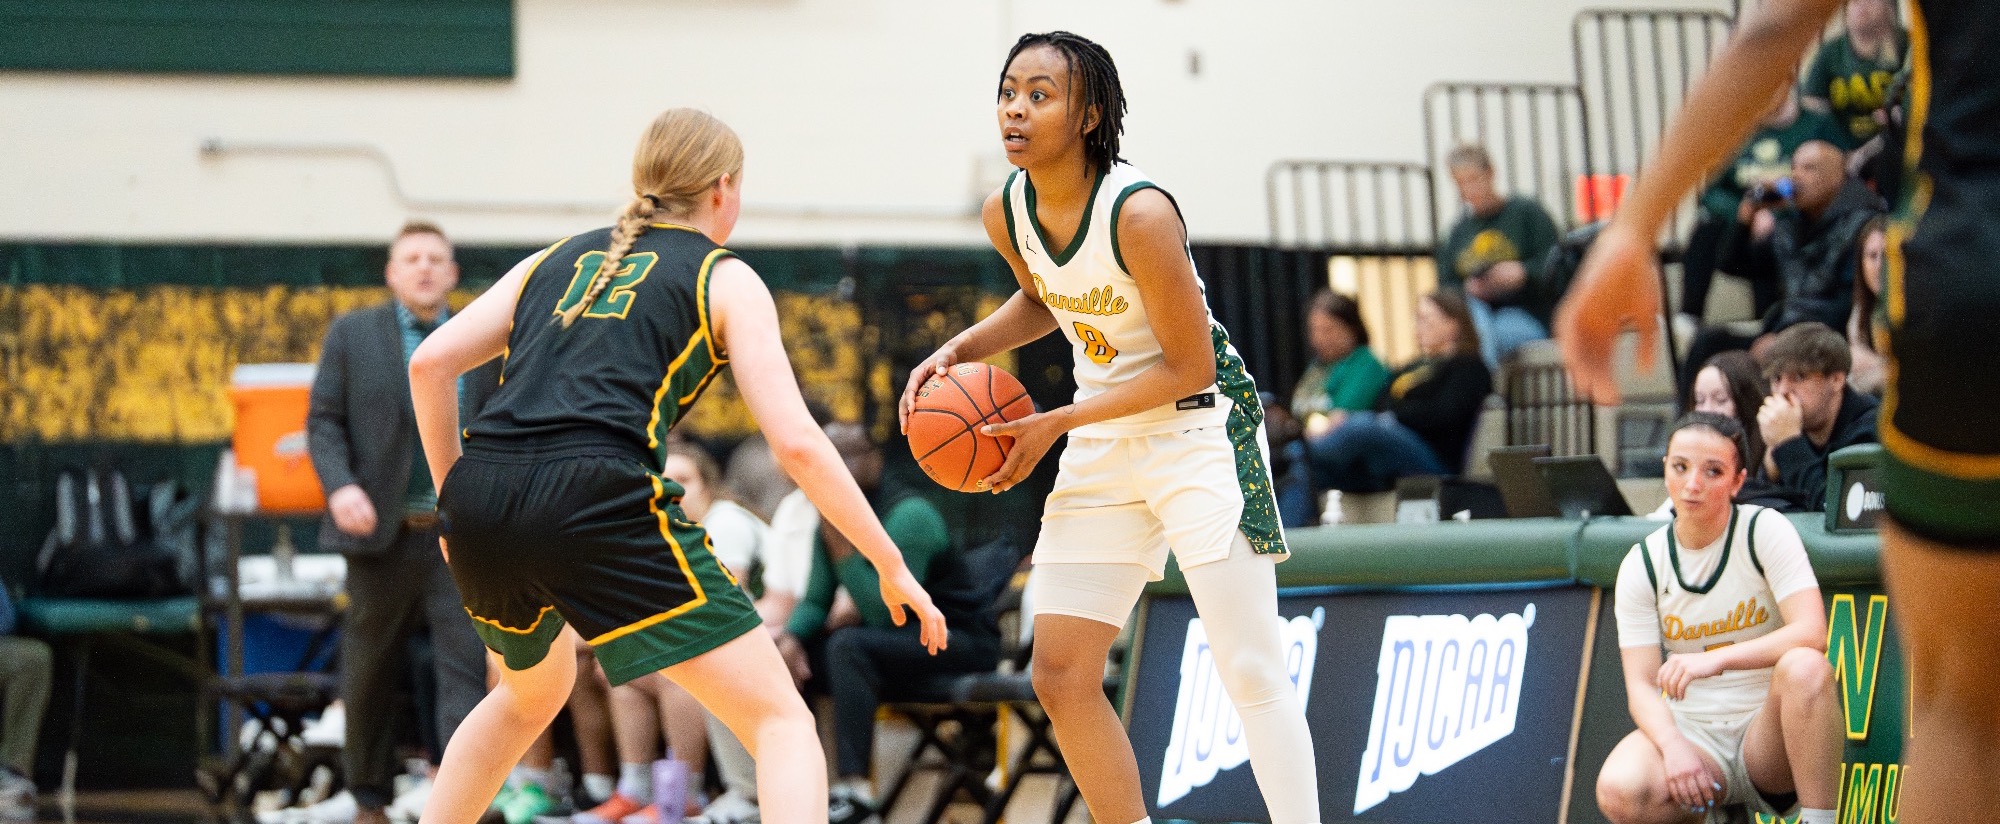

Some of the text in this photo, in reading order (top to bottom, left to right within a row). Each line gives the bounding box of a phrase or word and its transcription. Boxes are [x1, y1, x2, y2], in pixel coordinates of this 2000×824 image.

[552, 250, 659, 320] 12
[1032, 272, 1129, 316] Danville
[1203, 395, 1210, 403] S
[1663, 596, 1769, 640] Danville
[1364, 628, 1520, 795] NJCAA
